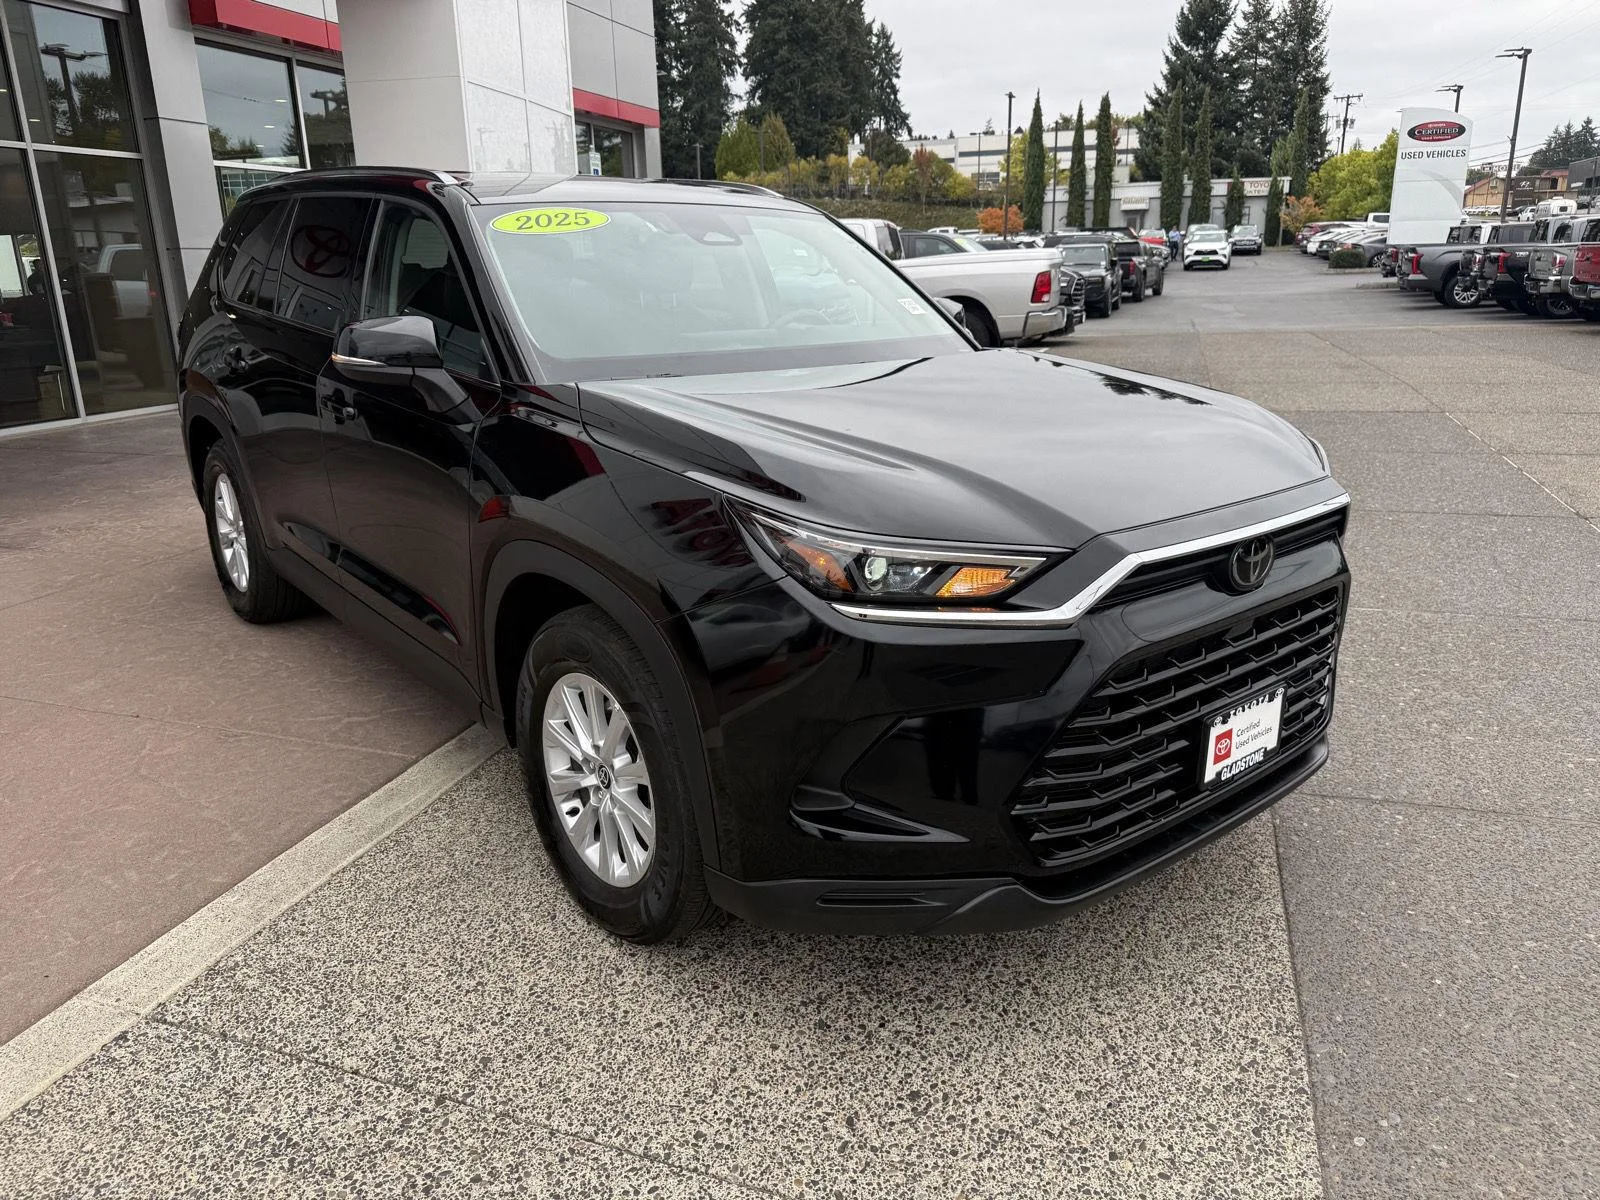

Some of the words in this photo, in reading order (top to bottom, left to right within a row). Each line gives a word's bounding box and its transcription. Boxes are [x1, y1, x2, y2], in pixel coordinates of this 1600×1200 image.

[1401, 151, 1424, 160] USED
[1426, 149, 1466, 159] VEHICLES
[515, 212, 590, 230] 2025
[1229, 695, 1269, 718] TOYOTA
[1235, 736, 1250, 750] Used
[1250, 726, 1272, 742] Vehicles
[1236, 718, 1261, 738] Certified
[1221, 749, 1264, 781] GLADSTONE
